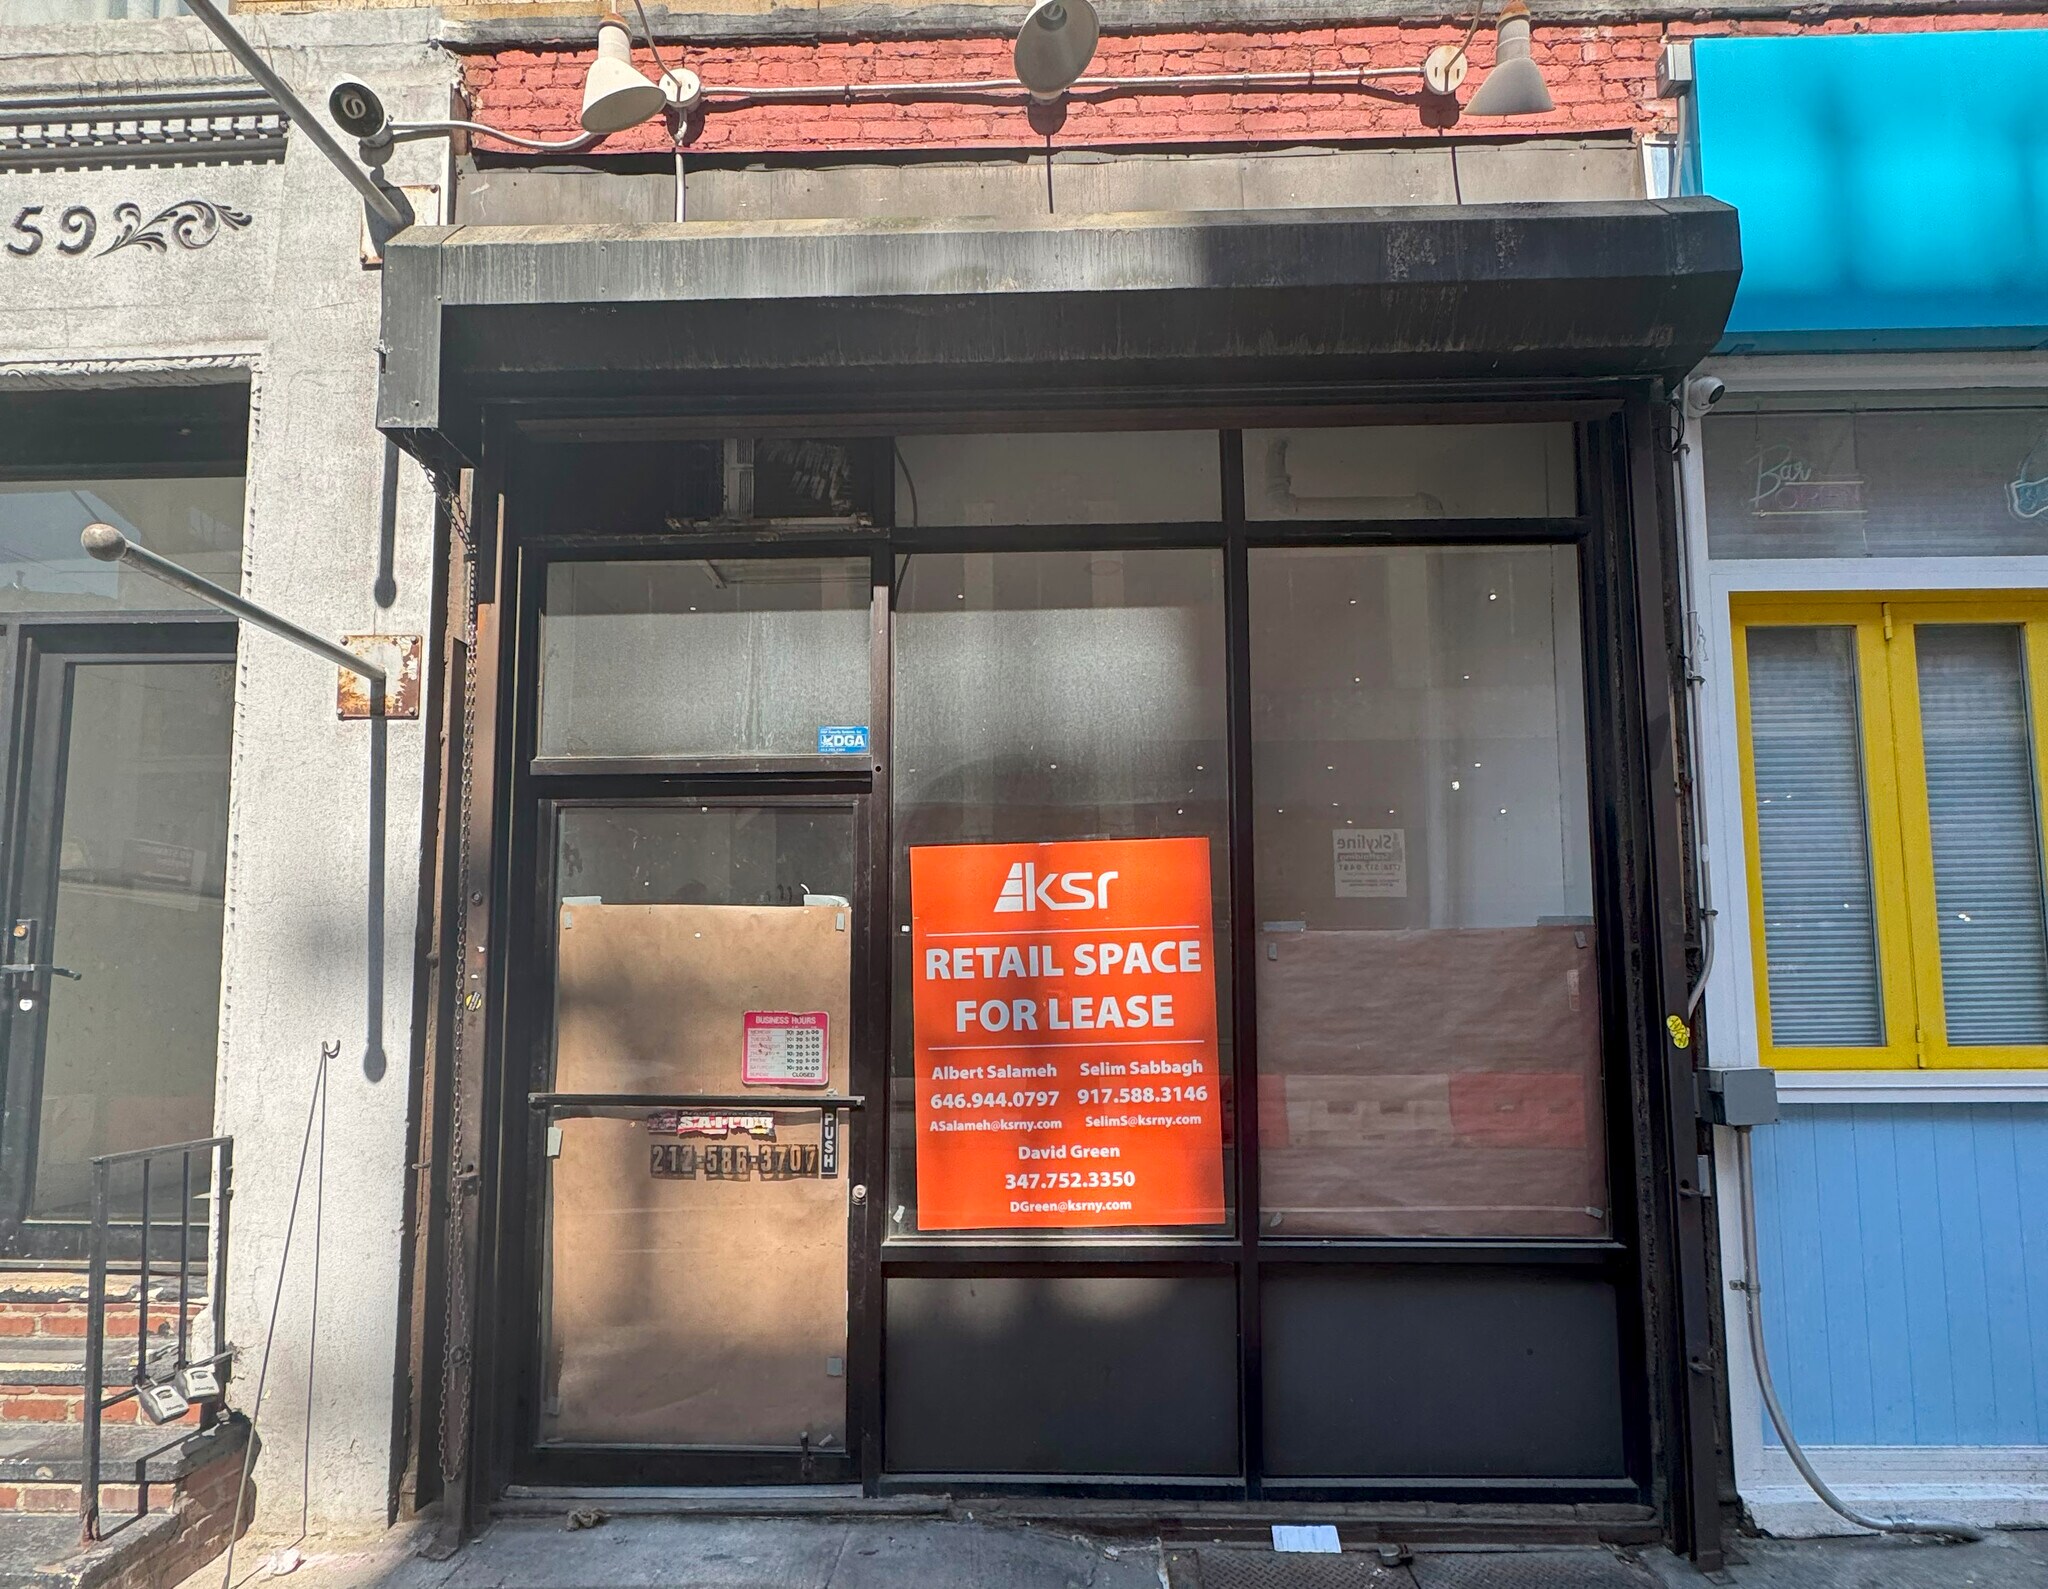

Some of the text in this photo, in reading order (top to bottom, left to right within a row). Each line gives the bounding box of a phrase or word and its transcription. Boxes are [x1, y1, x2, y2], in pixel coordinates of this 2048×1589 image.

[5, 205, 97, 256] 59
[1747, 444, 1812, 508] Bar
[1025, 862, 1119, 911] ksr
[925, 941, 1202, 980] RETAIL SPACE
[755, 1016, 816, 1025] BUSINESS HOURS
[956, 994, 1175, 1033] FOR LEASE
[931, 1063, 1057, 1080] Albert Salameh
[1080, 1059, 1204, 1080] Selim Sabbagh
[930, 1091, 1060, 1110] 646.944.0797
[1077, 1086, 1208, 1105] 917.588.3146
[929, 1118, 1062, 1132] ASalameh@ksrny.com
[1085, 1114, 1202, 1128] SelimS@ksrny.com
[824, 1112, 834, 1168] PUSH
[1018, 1144, 1121, 1160] David Green
[1005, 1170, 1136, 1190] 347.752.3350
[1009, 1199, 1132, 1214] DGreen@ksrny.com
